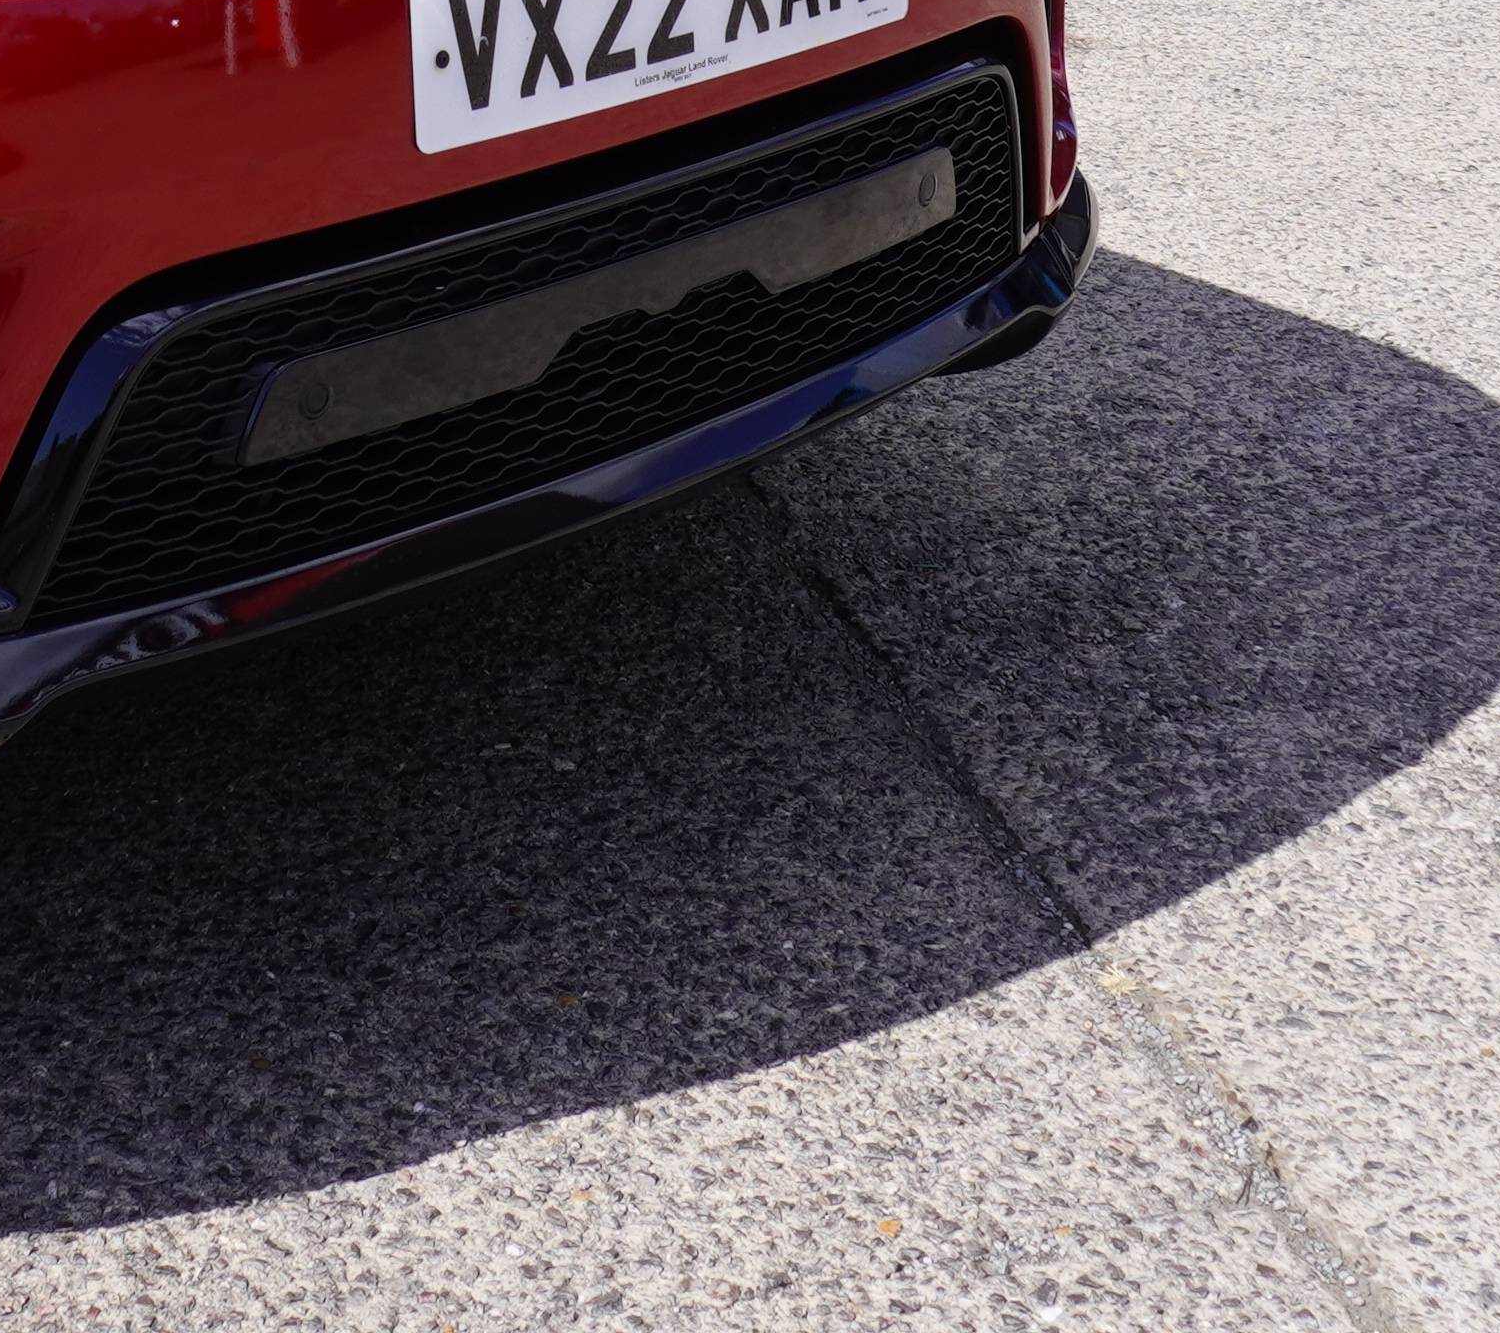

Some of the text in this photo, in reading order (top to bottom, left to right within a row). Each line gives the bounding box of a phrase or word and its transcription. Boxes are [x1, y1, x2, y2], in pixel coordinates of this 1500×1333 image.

[634, 74, 660, 87] Listers
[662, 66, 687, 80] Jaguar
[689, 59, 706, 72] Land
[707, 54, 729, 67] Rover
